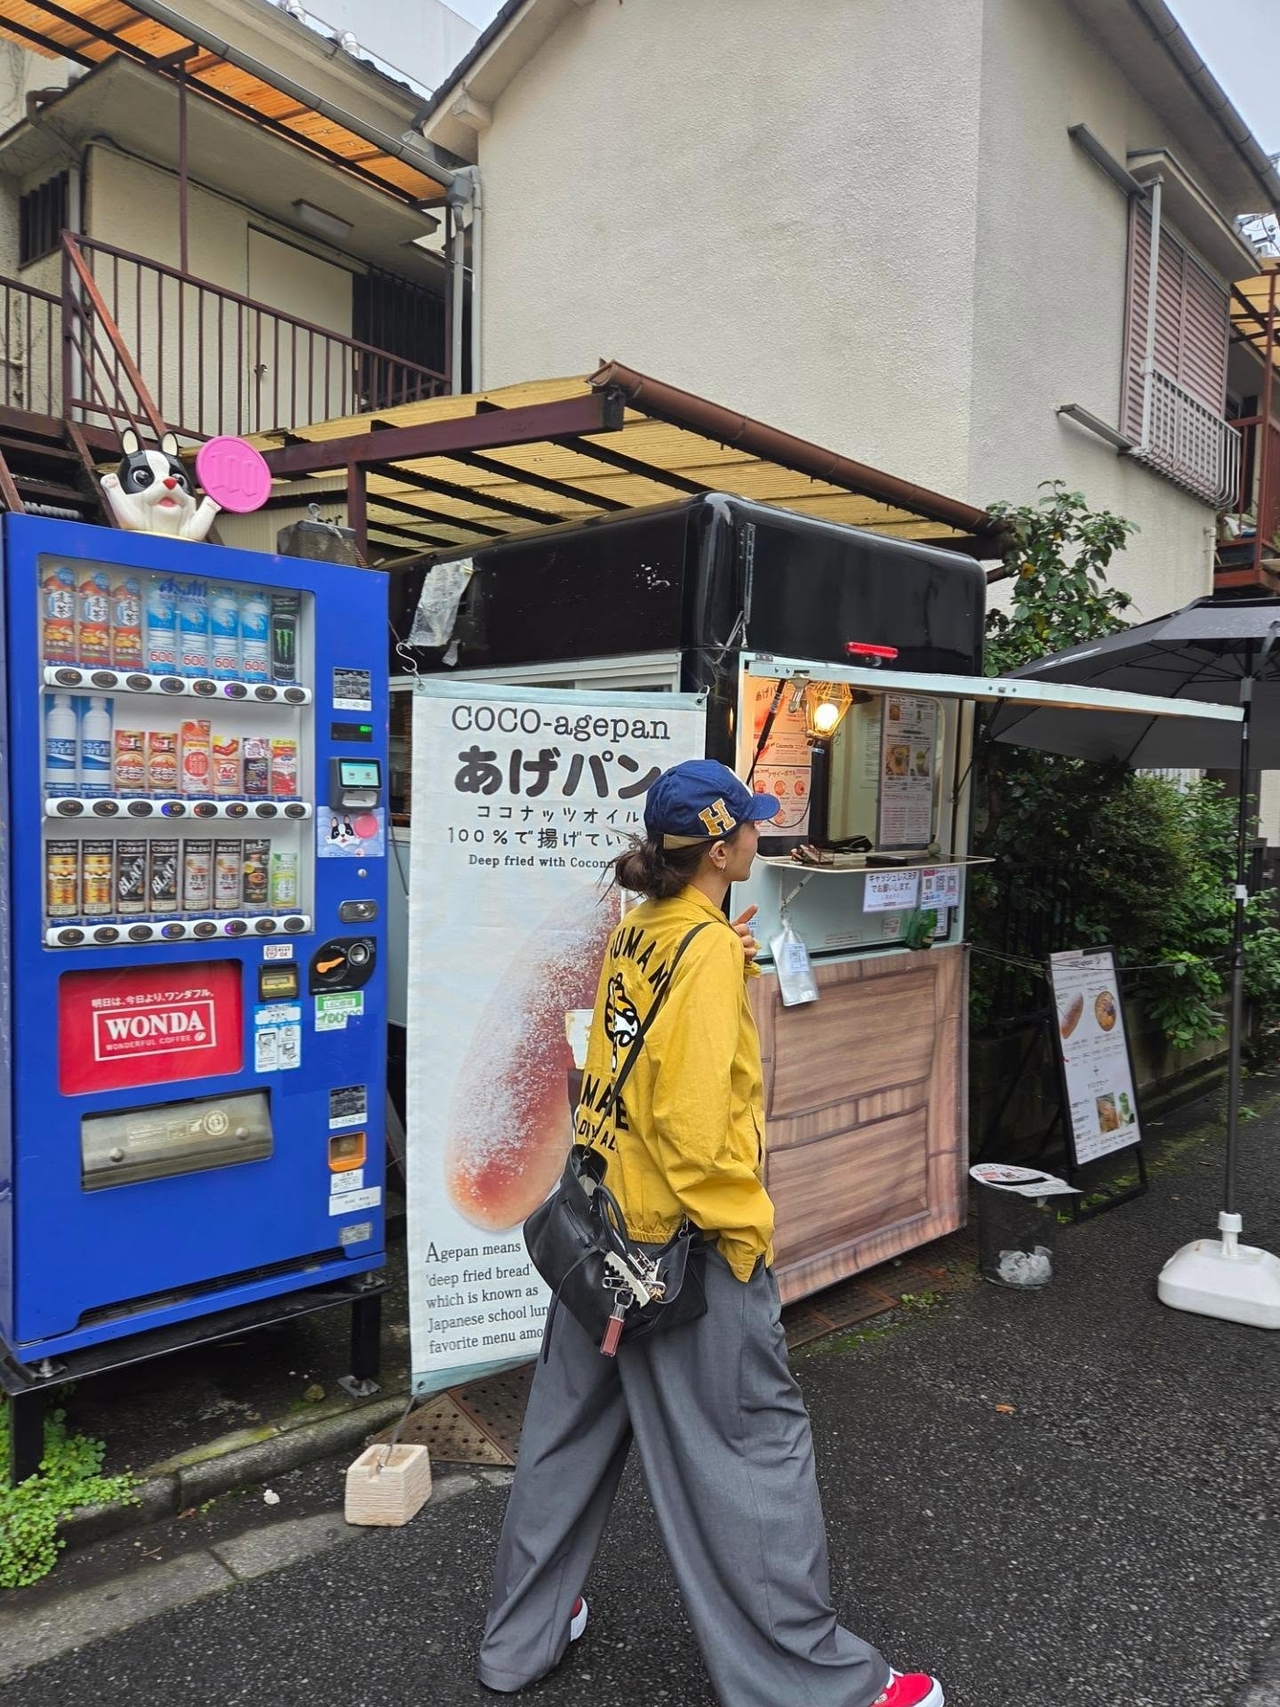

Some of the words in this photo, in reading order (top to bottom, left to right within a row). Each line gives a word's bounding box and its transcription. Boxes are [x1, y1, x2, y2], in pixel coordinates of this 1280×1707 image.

[451, 704, 671, 743] COCO-agepan
[454, 744, 662, 800] あげパン
[477, 805, 640, 824] ココナッツオイル
[698, 797, 737, 836] H
[468, 854, 500, 868] Deep
[504, 856, 535, 868] fried
[538, 856, 567, 869] with
[91, 989, 215, 1008] 明日は、今日より、ワンダフル。
[105, 1010, 205, 1040] WONDA
[105, 1038, 157, 1051] WONDERFUL
[159, 1034, 192, 1045] COFFEE
[425, 1241, 478, 1263] Agepan
[482, 1242, 521, 1255] means
[463, 1268, 493, 1283] fried
[427, 1293, 464, 1309] which
[468, 1292, 478, 1303] is
[482, 1288, 522, 1302] known
[525, 1286, 539, 1296] as
[428, 1314, 485, 1333] Japanese
[488, 1306, 527, 1322] school
[429, 1337, 479, 1354] favorite
[482, 1332, 516, 1346] menu
